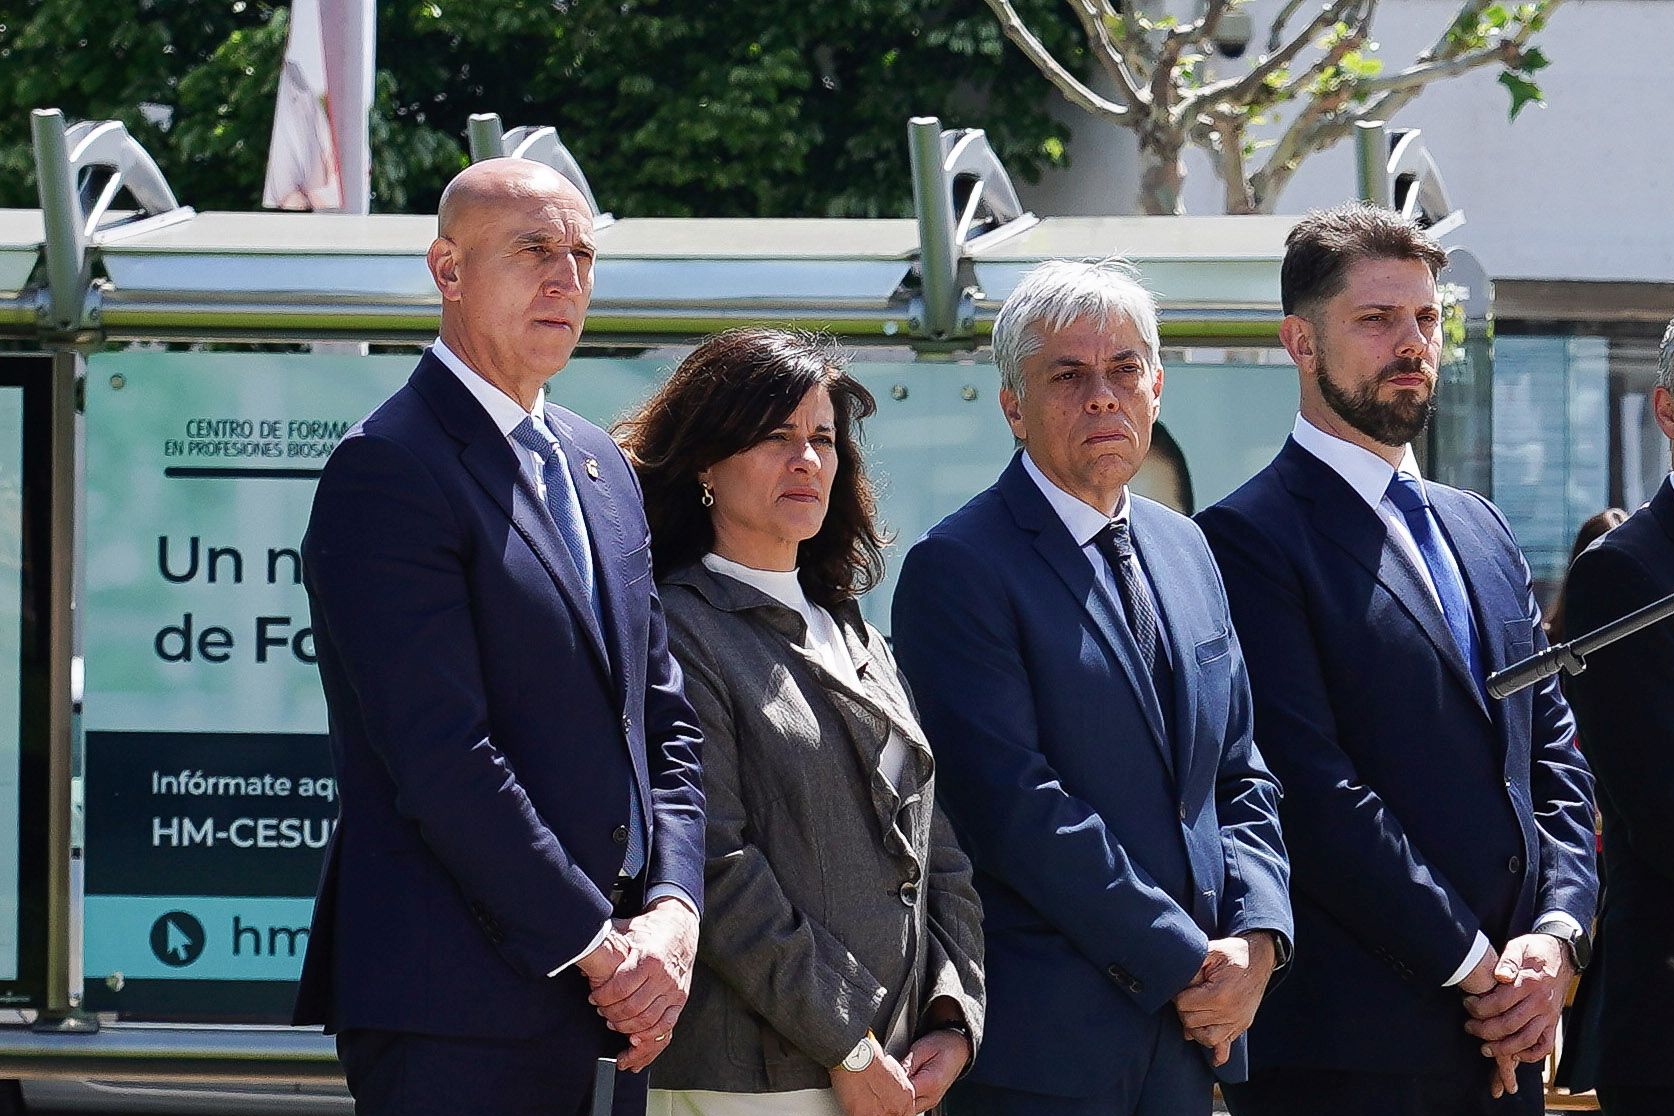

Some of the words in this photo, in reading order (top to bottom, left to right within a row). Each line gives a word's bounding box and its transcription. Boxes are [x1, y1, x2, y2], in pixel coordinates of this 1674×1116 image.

[186, 419, 253, 438] CENTRO
[260, 420, 282, 438] DE
[164, 439, 184, 457] EN
[188, 440, 282, 457] PROFESIONES
[287, 440, 334, 458] BIOSA
[157, 535, 244, 584] Un
[154, 612, 234, 663] de
[255, 616, 319, 665] Fo
[151, 769, 293, 797] Infórmate
[298, 777, 338, 803] aq
[151, 816, 338, 849] HM-CESU
